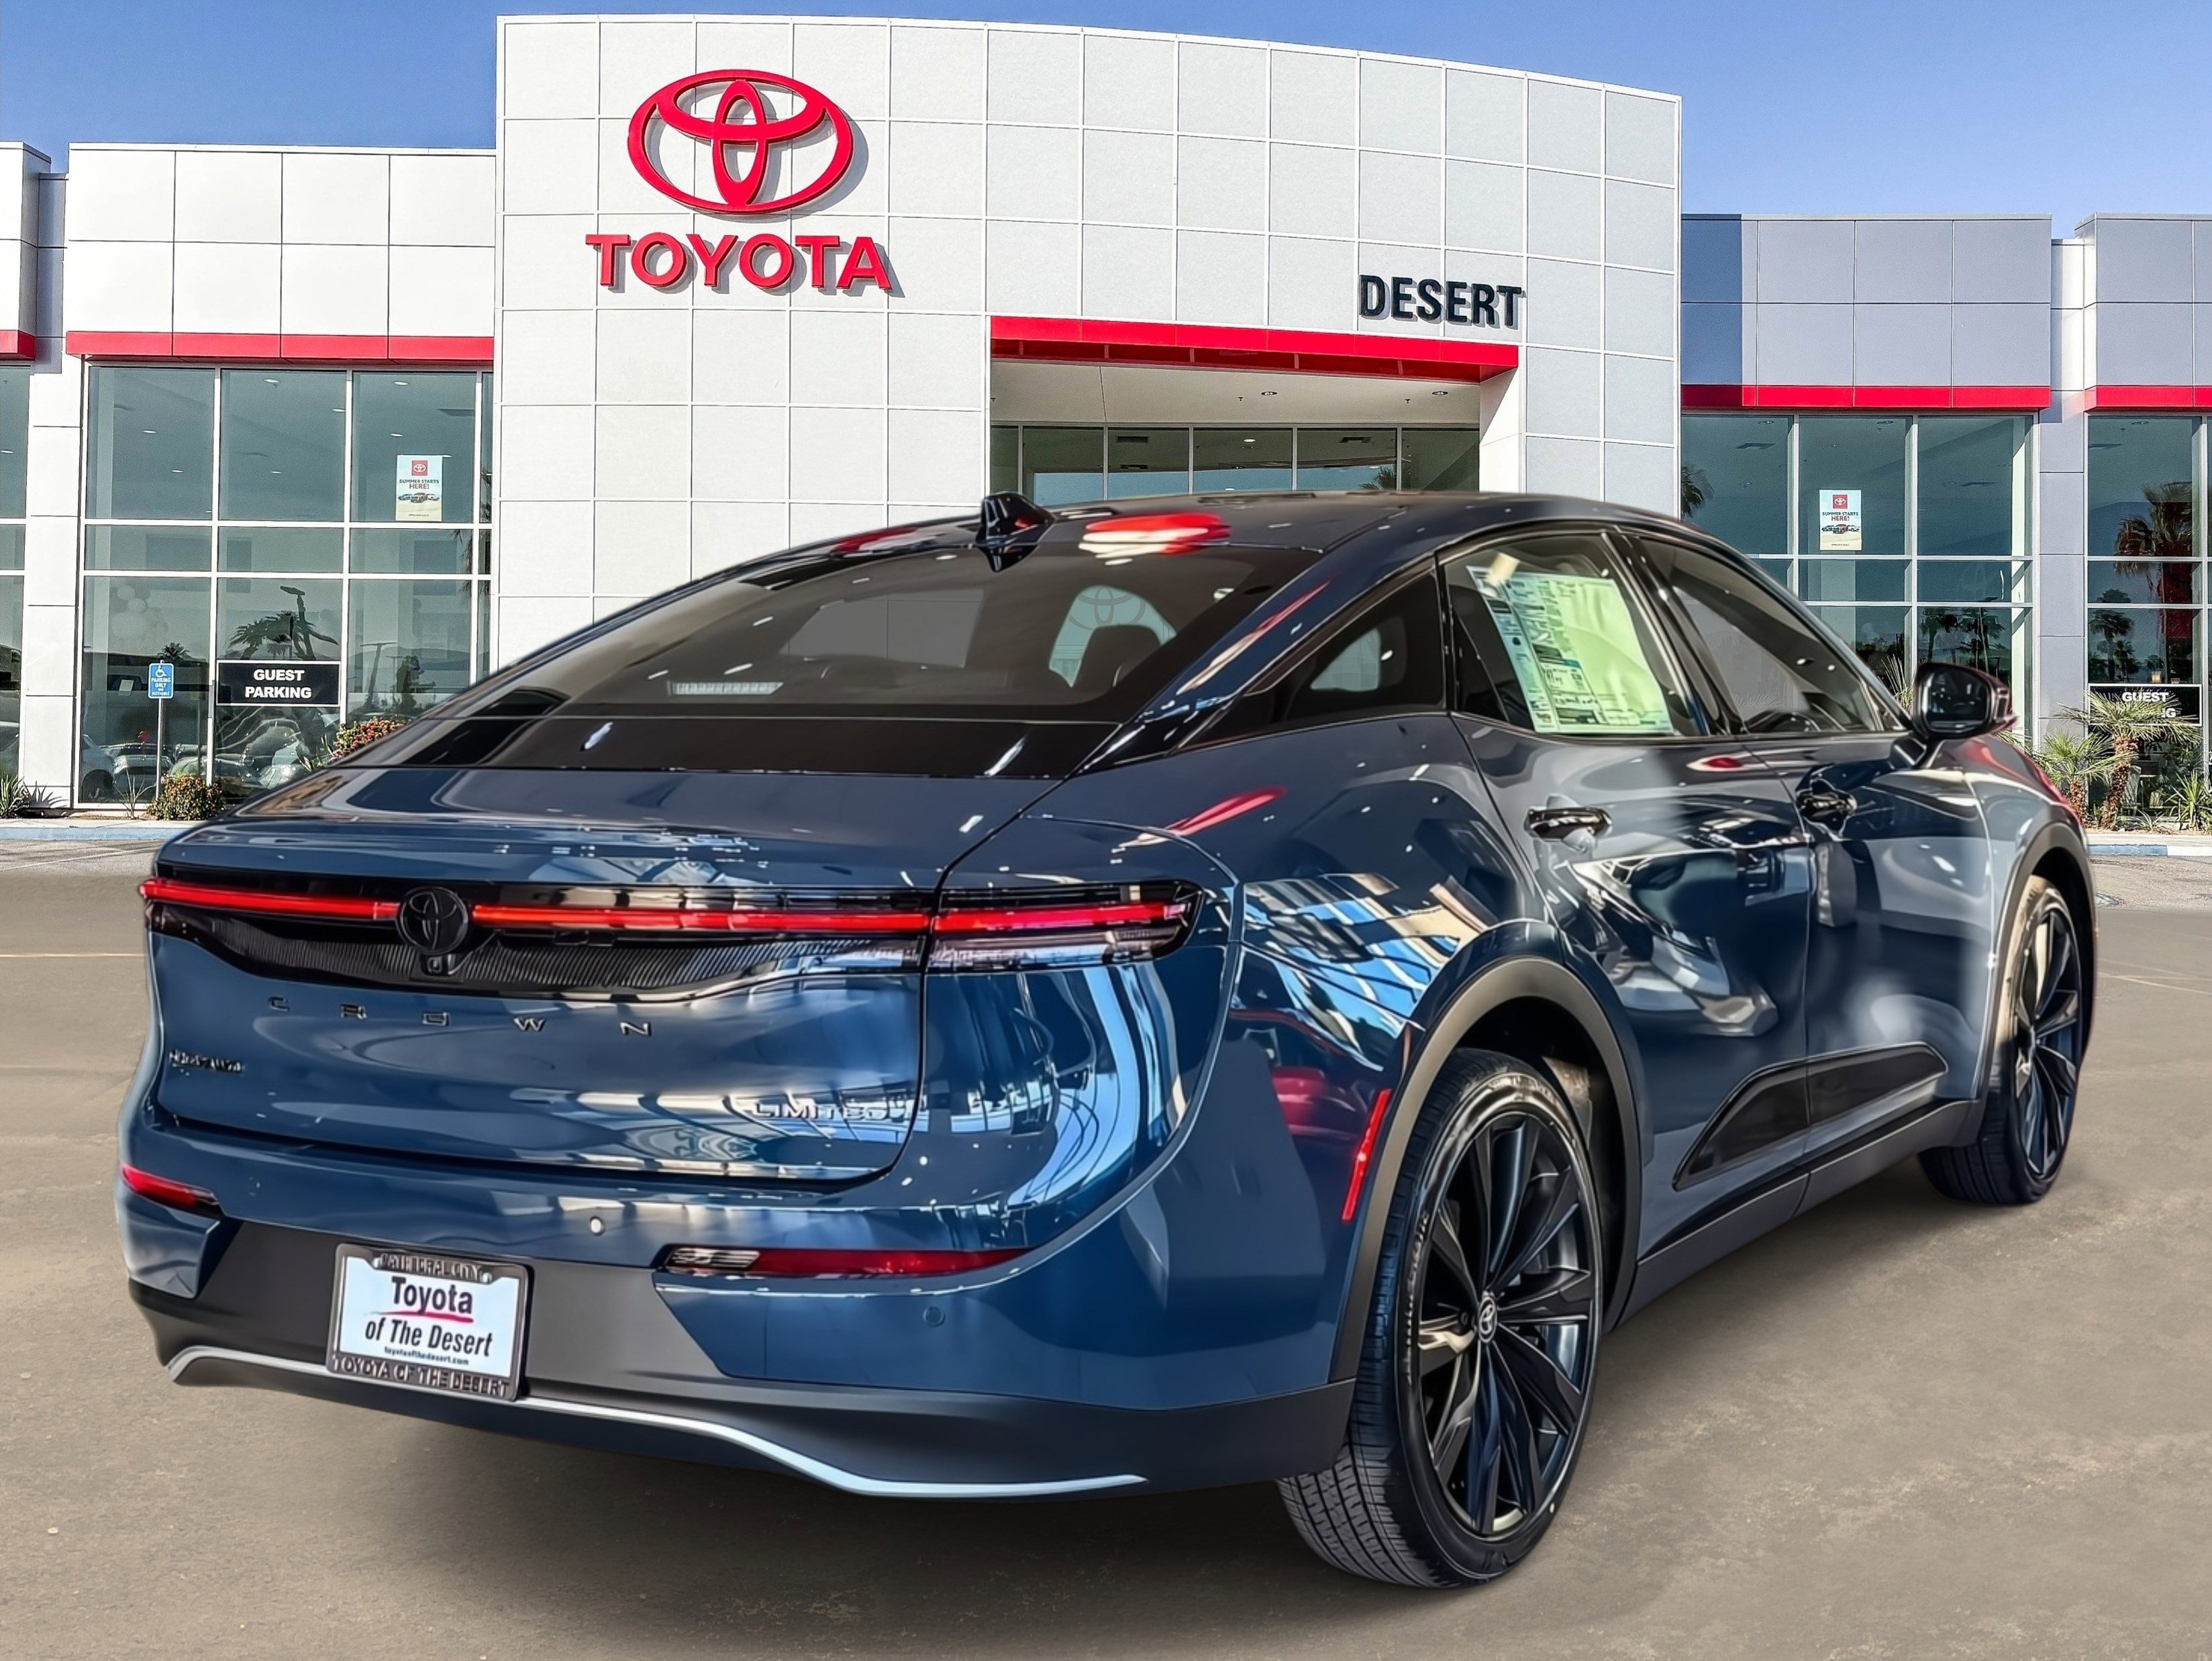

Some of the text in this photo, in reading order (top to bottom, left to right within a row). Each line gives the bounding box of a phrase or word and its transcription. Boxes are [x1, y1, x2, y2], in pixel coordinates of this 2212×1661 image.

[585, 232, 893, 290] TOYOTA
[1358, 274, 1523, 328] DESERT
[245, 687, 311, 699] PARKING
[253, 669, 305, 681] GUEST
[2121, 692, 2169, 702] GUEST
[391, 1276, 474, 1315] Toyota
[364, 1317, 493, 1357] of The Desert
[385, 1346, 469, 1366] toyotaofthedesert.com
[332, 1354, 509, 1397] TOYOTA OF THE DESERT
